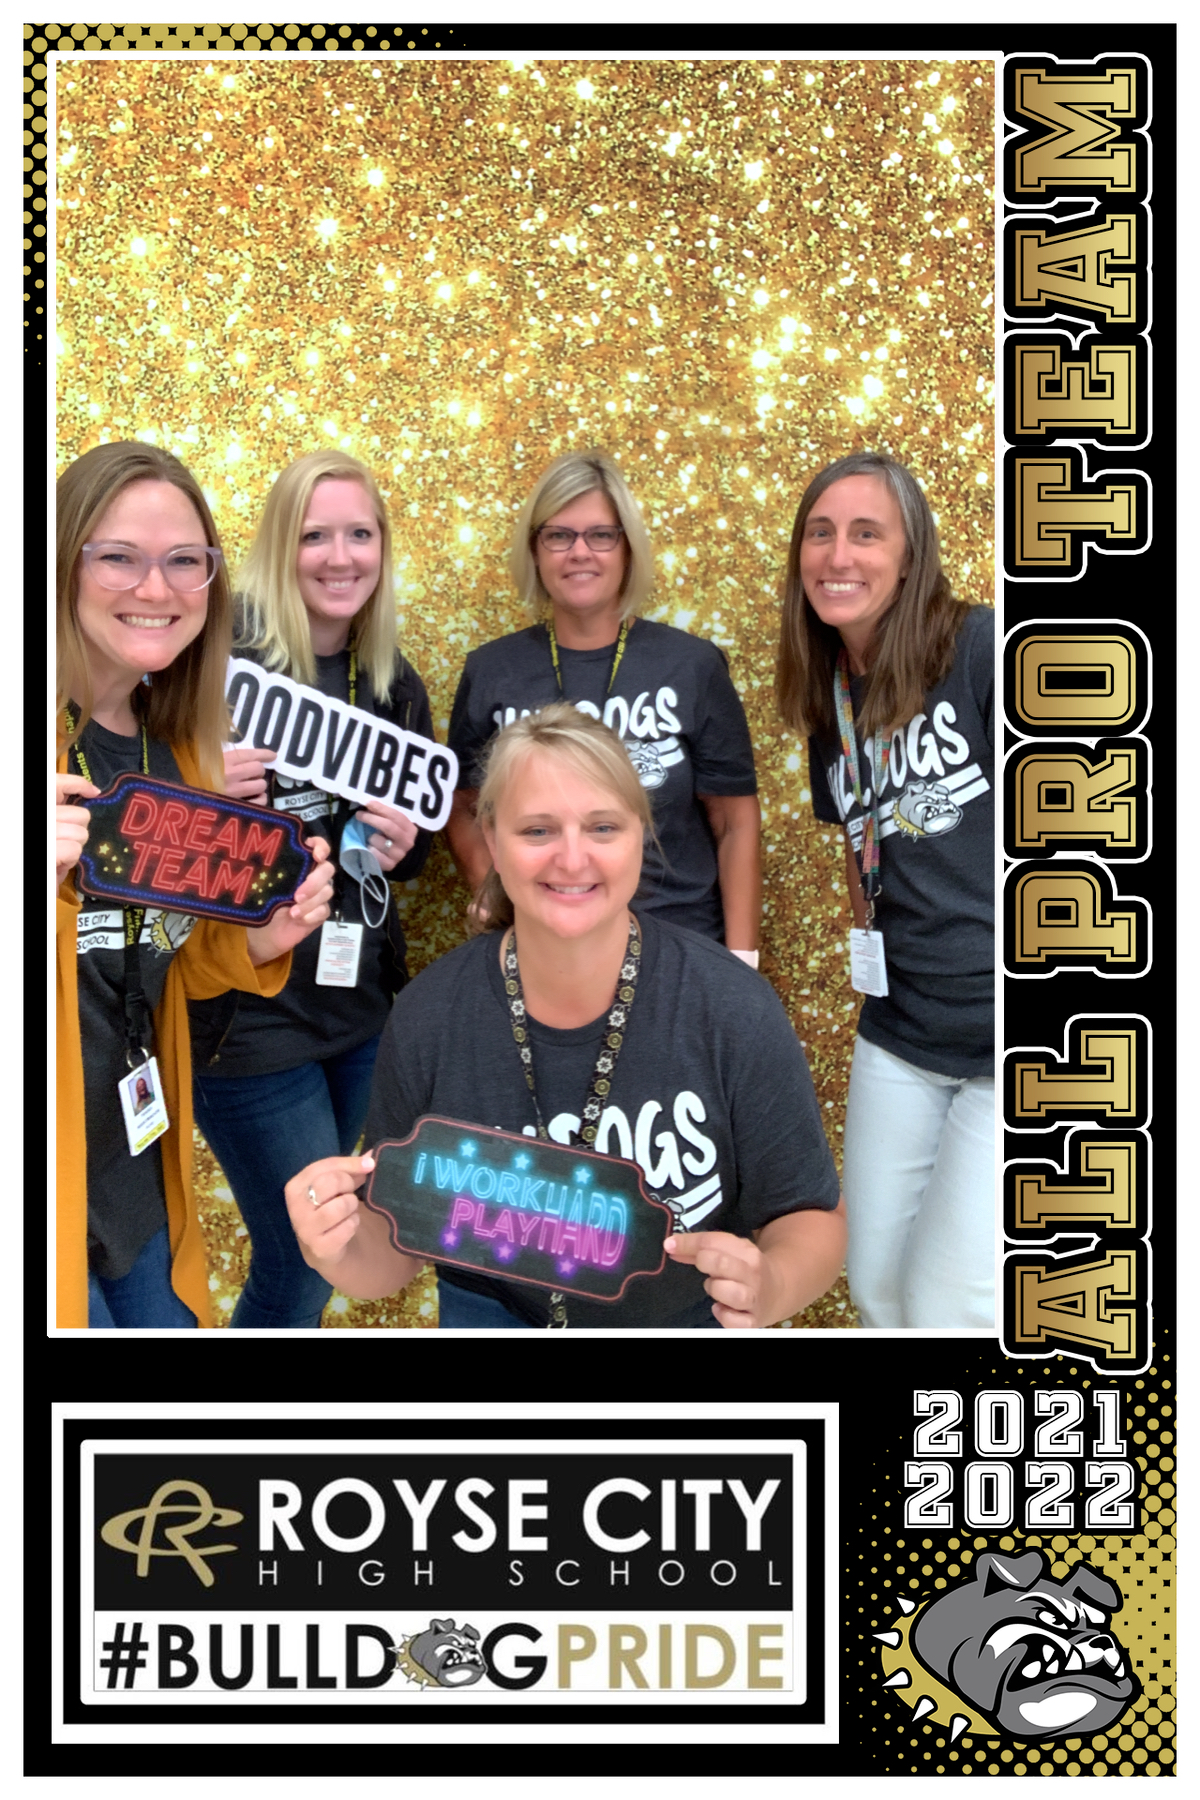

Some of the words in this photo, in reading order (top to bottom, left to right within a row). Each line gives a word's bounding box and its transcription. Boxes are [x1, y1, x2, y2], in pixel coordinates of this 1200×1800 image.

[226, 671, 451, 820] OODVIBES
[120, 793, 283, 867] DREAM
[131, 841, 254, 904] TEAM
